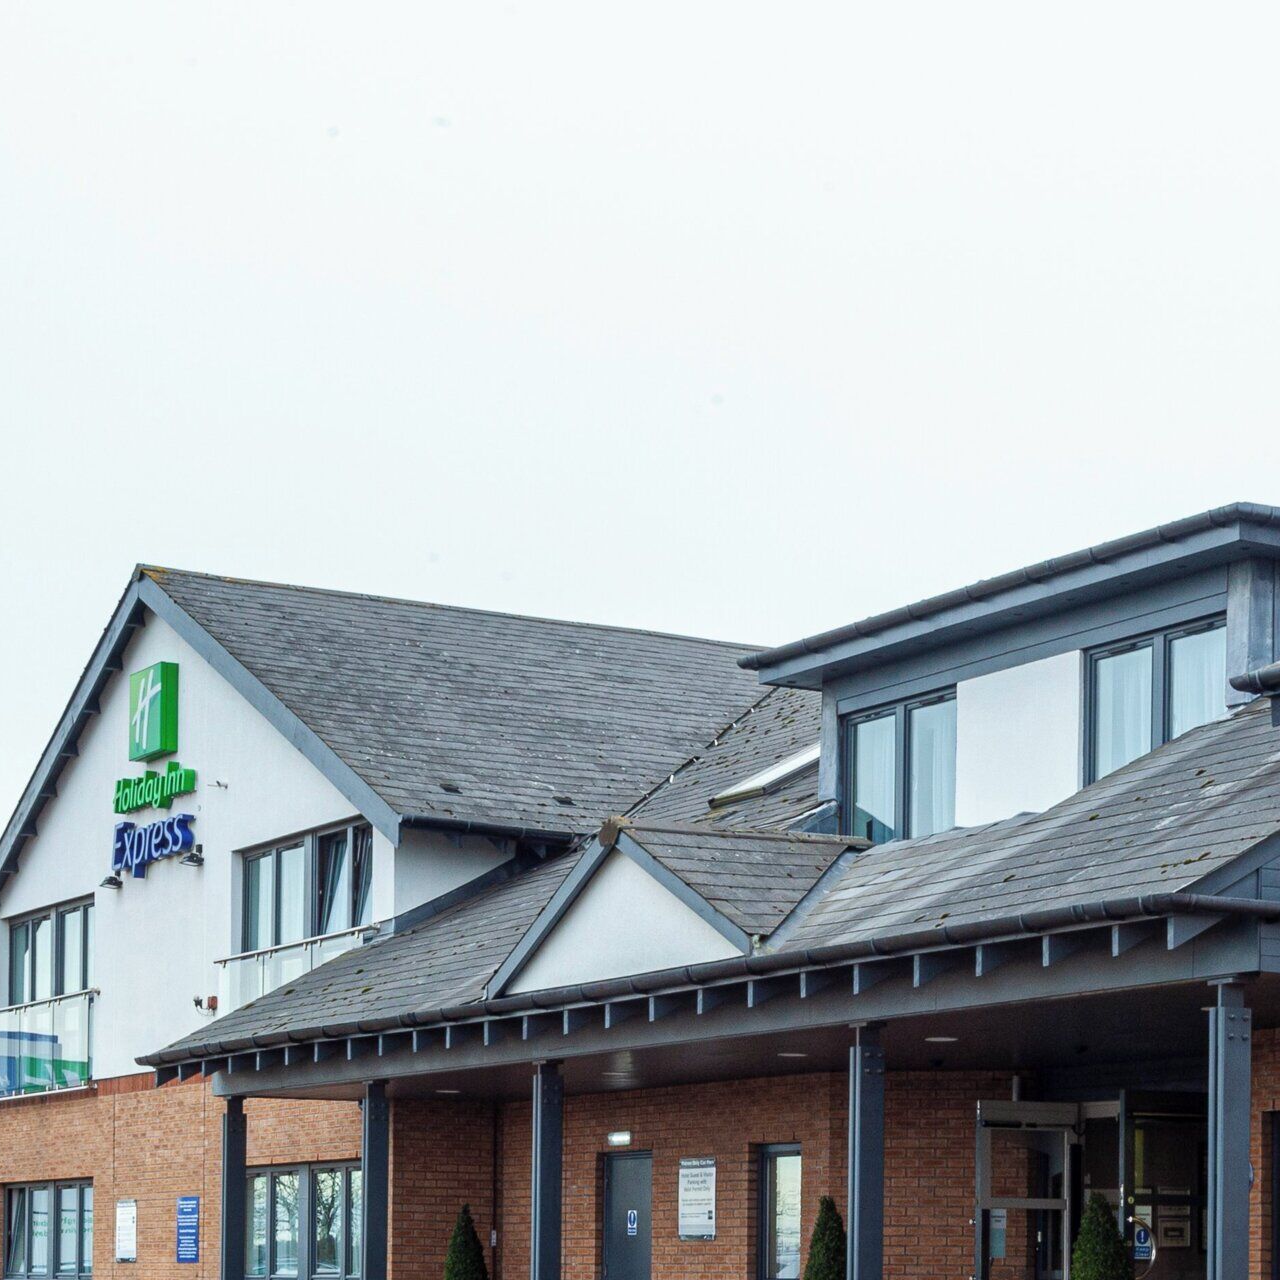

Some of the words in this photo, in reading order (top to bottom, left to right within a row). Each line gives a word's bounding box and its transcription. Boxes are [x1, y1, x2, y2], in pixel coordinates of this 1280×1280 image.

[113, 770, 161, 812] Holiday
[164, 762, 186, 797] Inn
[112, 814, 185, 877] Express
